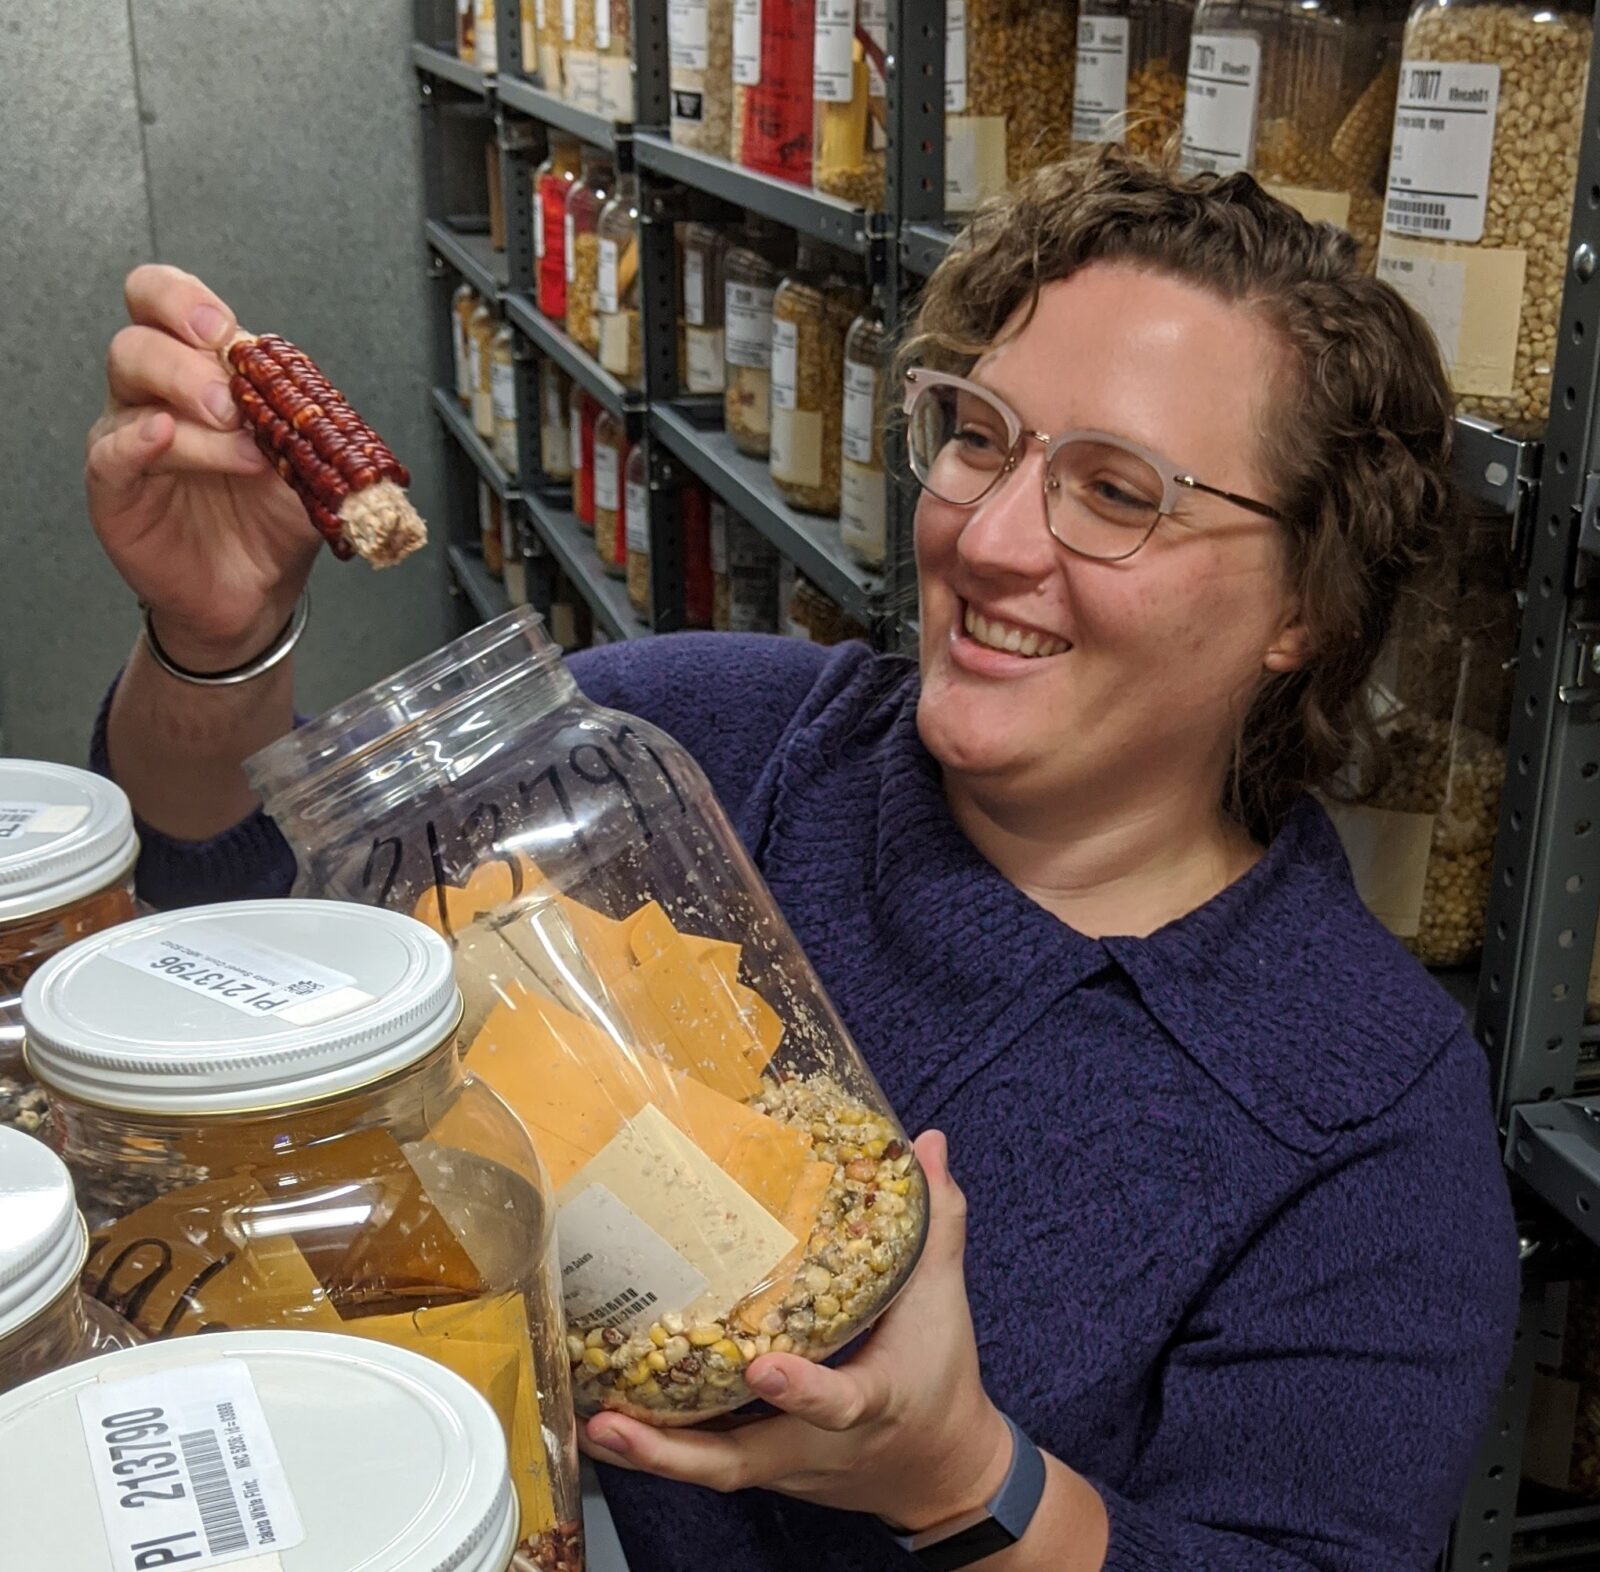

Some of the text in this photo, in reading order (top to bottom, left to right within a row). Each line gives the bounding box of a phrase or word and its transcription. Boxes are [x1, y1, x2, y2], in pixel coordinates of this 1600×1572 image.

[150, 957, 289, 1011] PI 213796
[101, 1407, 186, 1508] 213790
[248, 1498, 269, 1520] White
[130, 1531, 203, 1571] PI
[254, 1519, 276, 1544] Dakota
